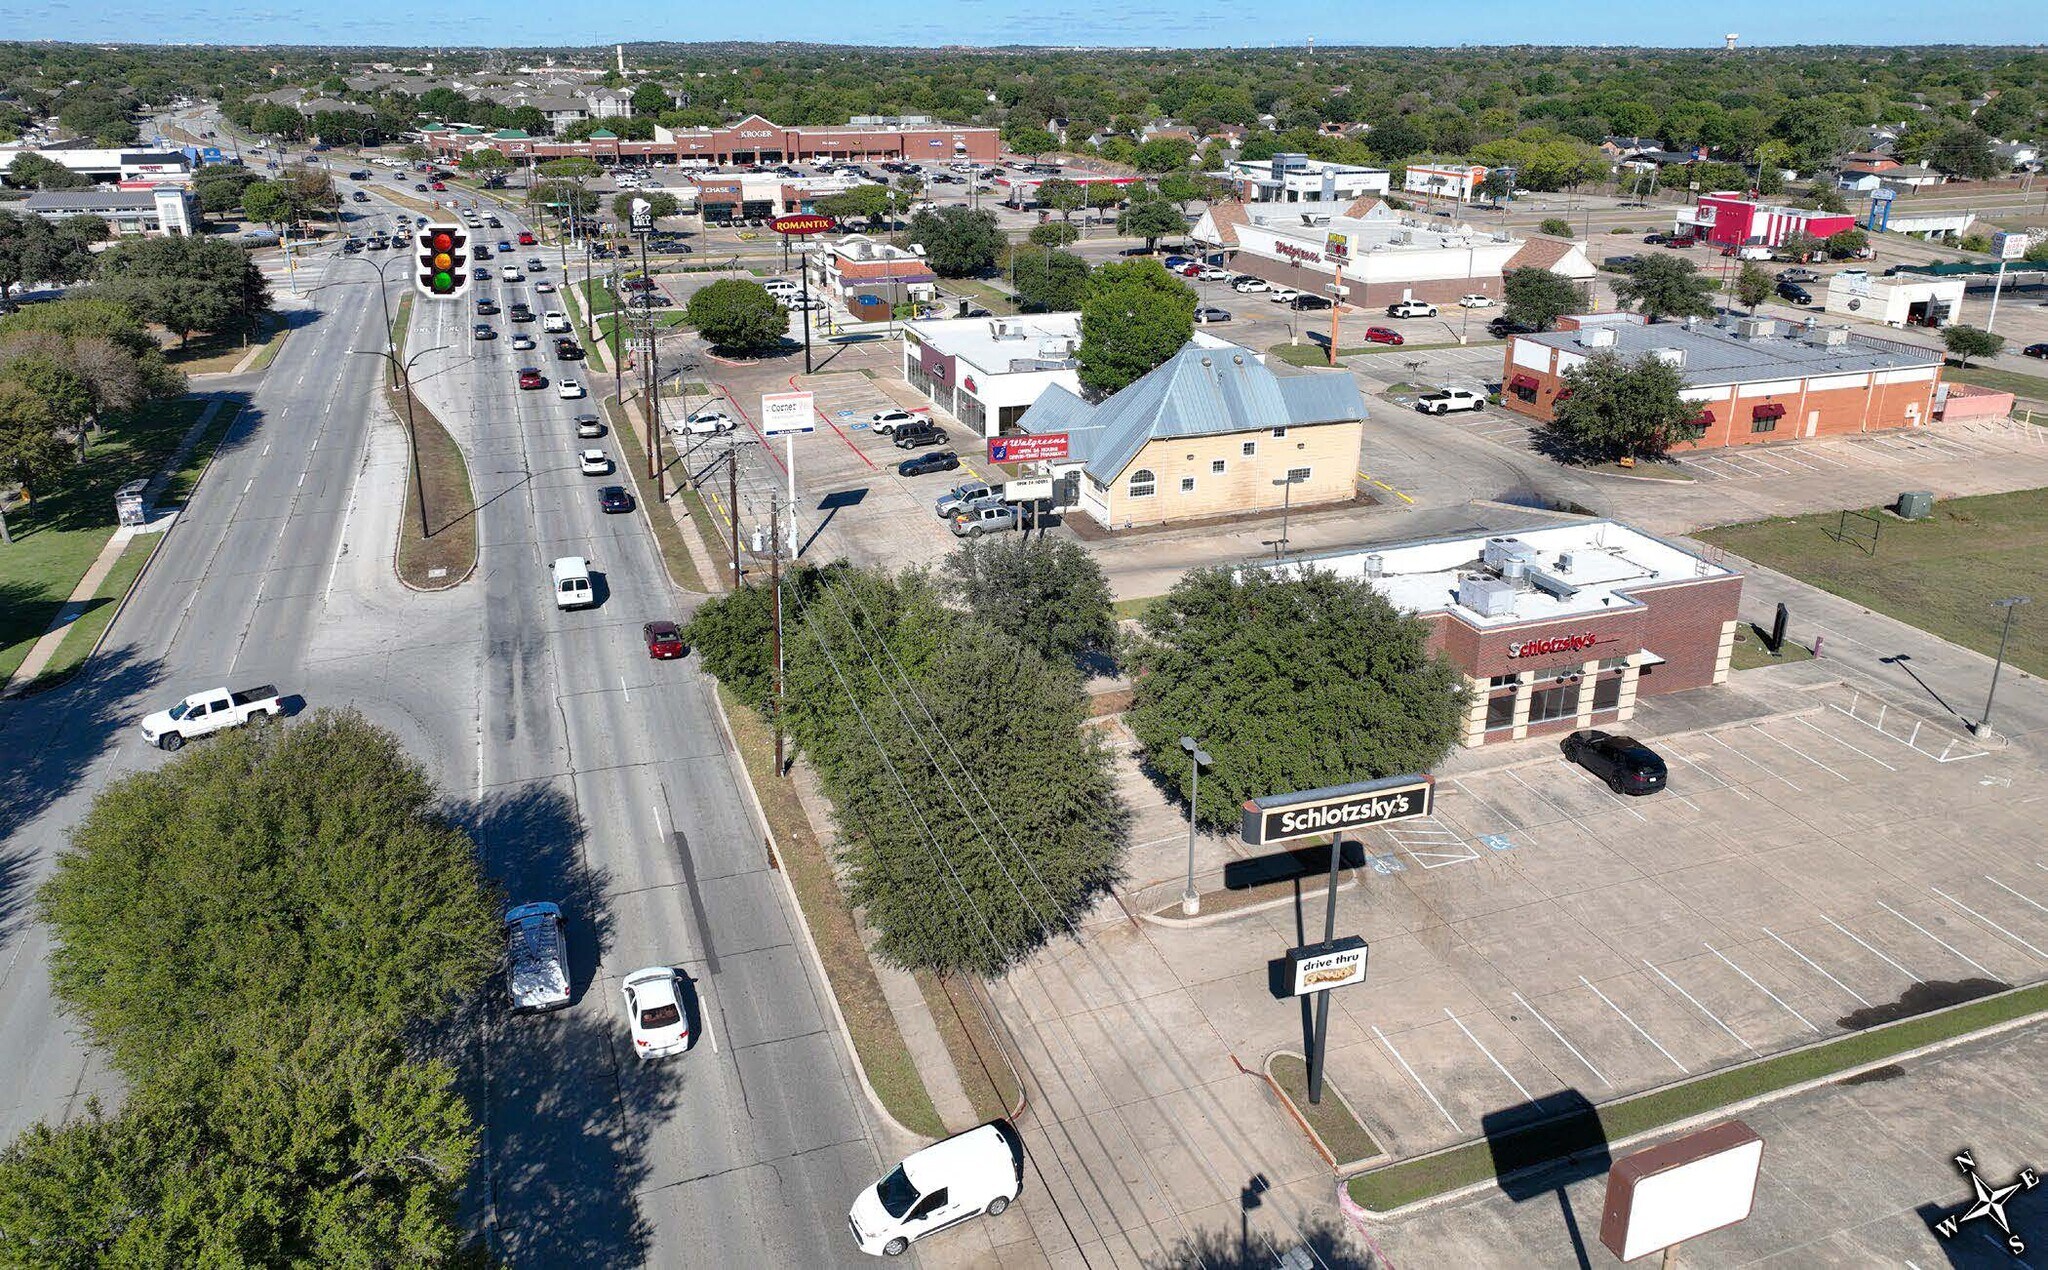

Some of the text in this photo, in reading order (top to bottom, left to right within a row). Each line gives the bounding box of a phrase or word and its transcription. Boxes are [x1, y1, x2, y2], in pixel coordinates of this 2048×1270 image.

[776, 220, 829, 231] ROMANTIX
[1275, 241, 1321, 263] Walgreens
[771, 403, 797, 412] Corner
[1008, 438, 1067, 448] Walgreens
[1508, 632, 1596, 658] Schlotzsky's
[1280, 794, 1409, 833] Schlotzsky's
[1303, 954, 1359, 971] drive thru
